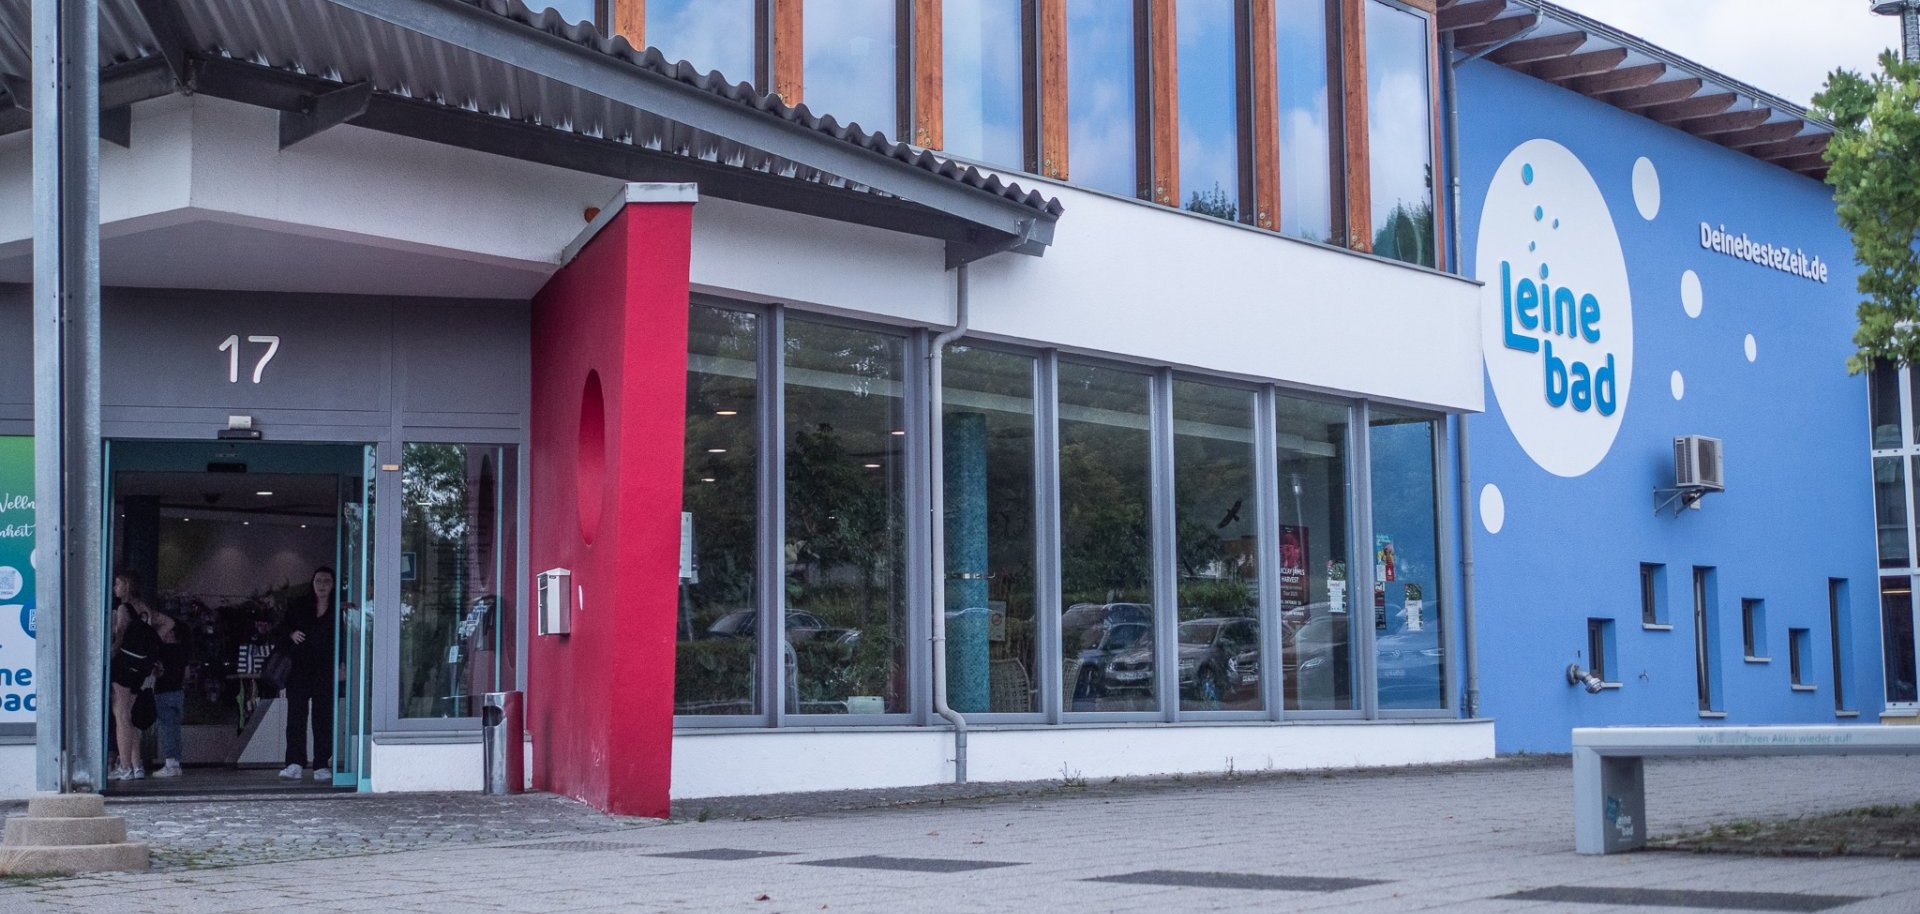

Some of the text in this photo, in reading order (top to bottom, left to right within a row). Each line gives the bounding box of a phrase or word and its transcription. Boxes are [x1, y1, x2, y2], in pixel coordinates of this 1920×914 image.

[1700, 221, 1828, 283] DeinebesteZeit.de
[1501, 260, 1601, 353] Leine
[219, 334, 280, 384] 17
[1544, 339, 1617, 417] bad
